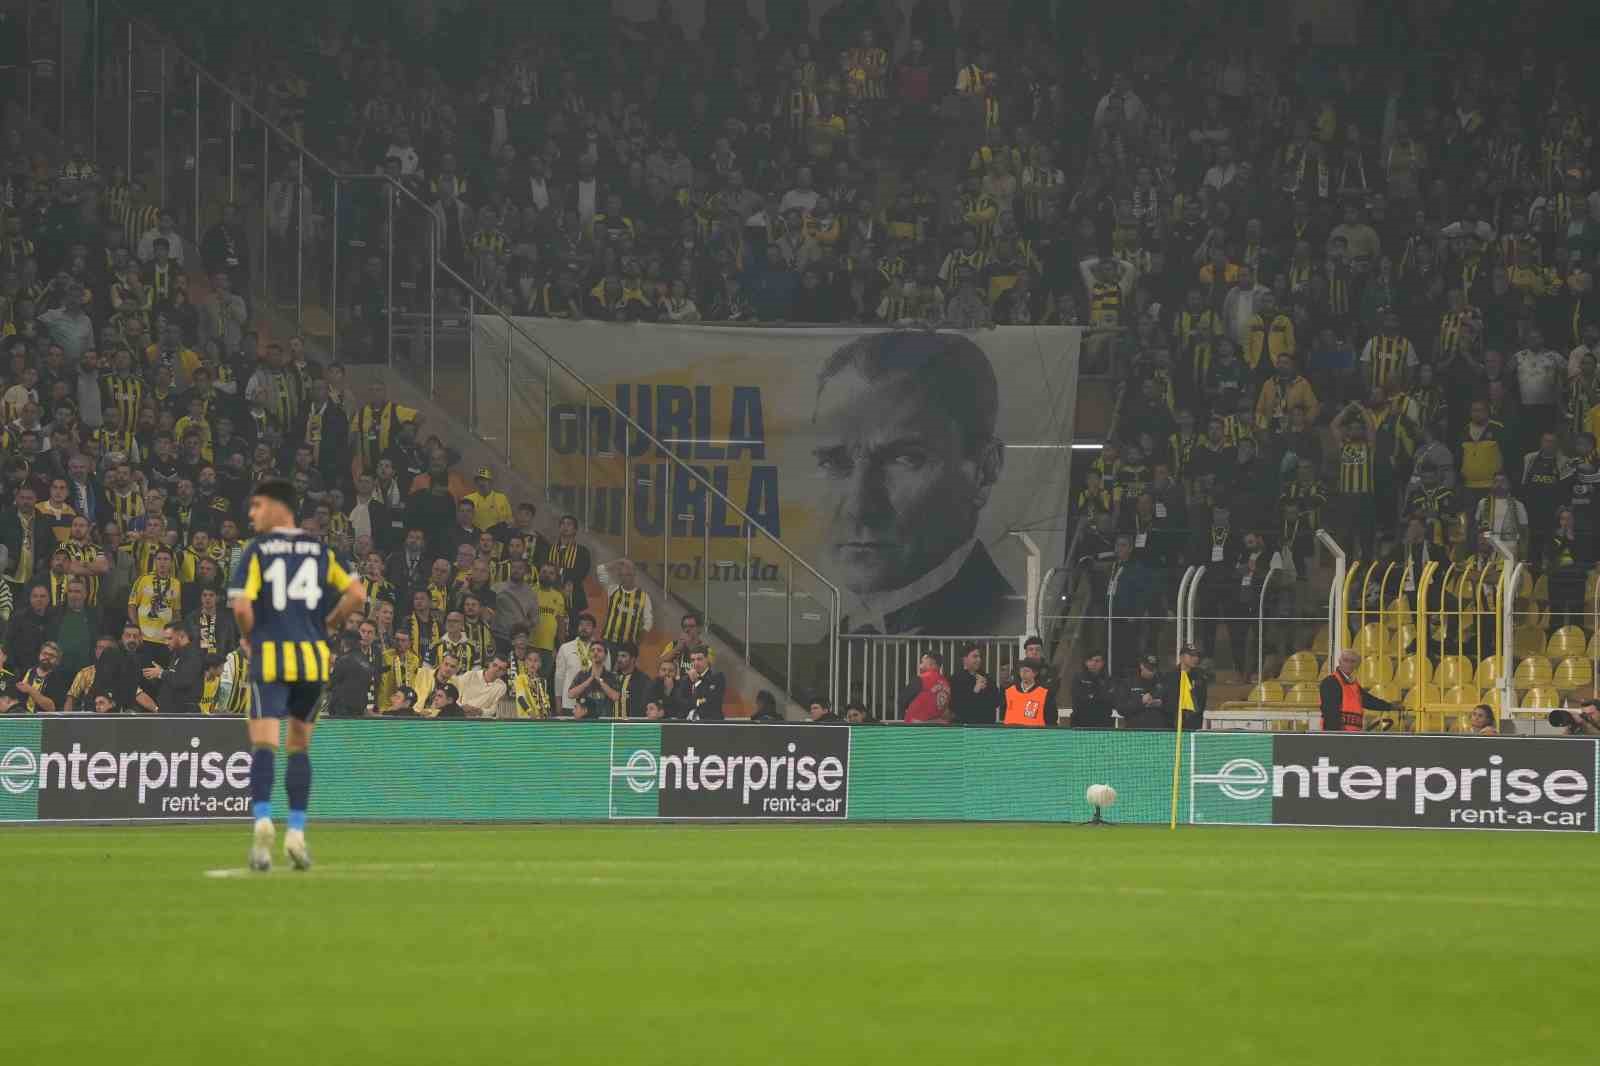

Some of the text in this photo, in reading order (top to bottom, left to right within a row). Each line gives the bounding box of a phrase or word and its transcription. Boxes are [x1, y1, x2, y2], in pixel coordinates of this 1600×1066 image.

[263, 557, 323, 611] 14
[0, 737, 252, 803] enterprise
[613, 743, 843, 804] enterprise
[1194, 755, 1588, 814] enterprise
[162, 794, 252, 812] rent-a-car
[763, 796, 842, 812] rent-a-car
[1450, 807, 1587, 826] rent-a-car
